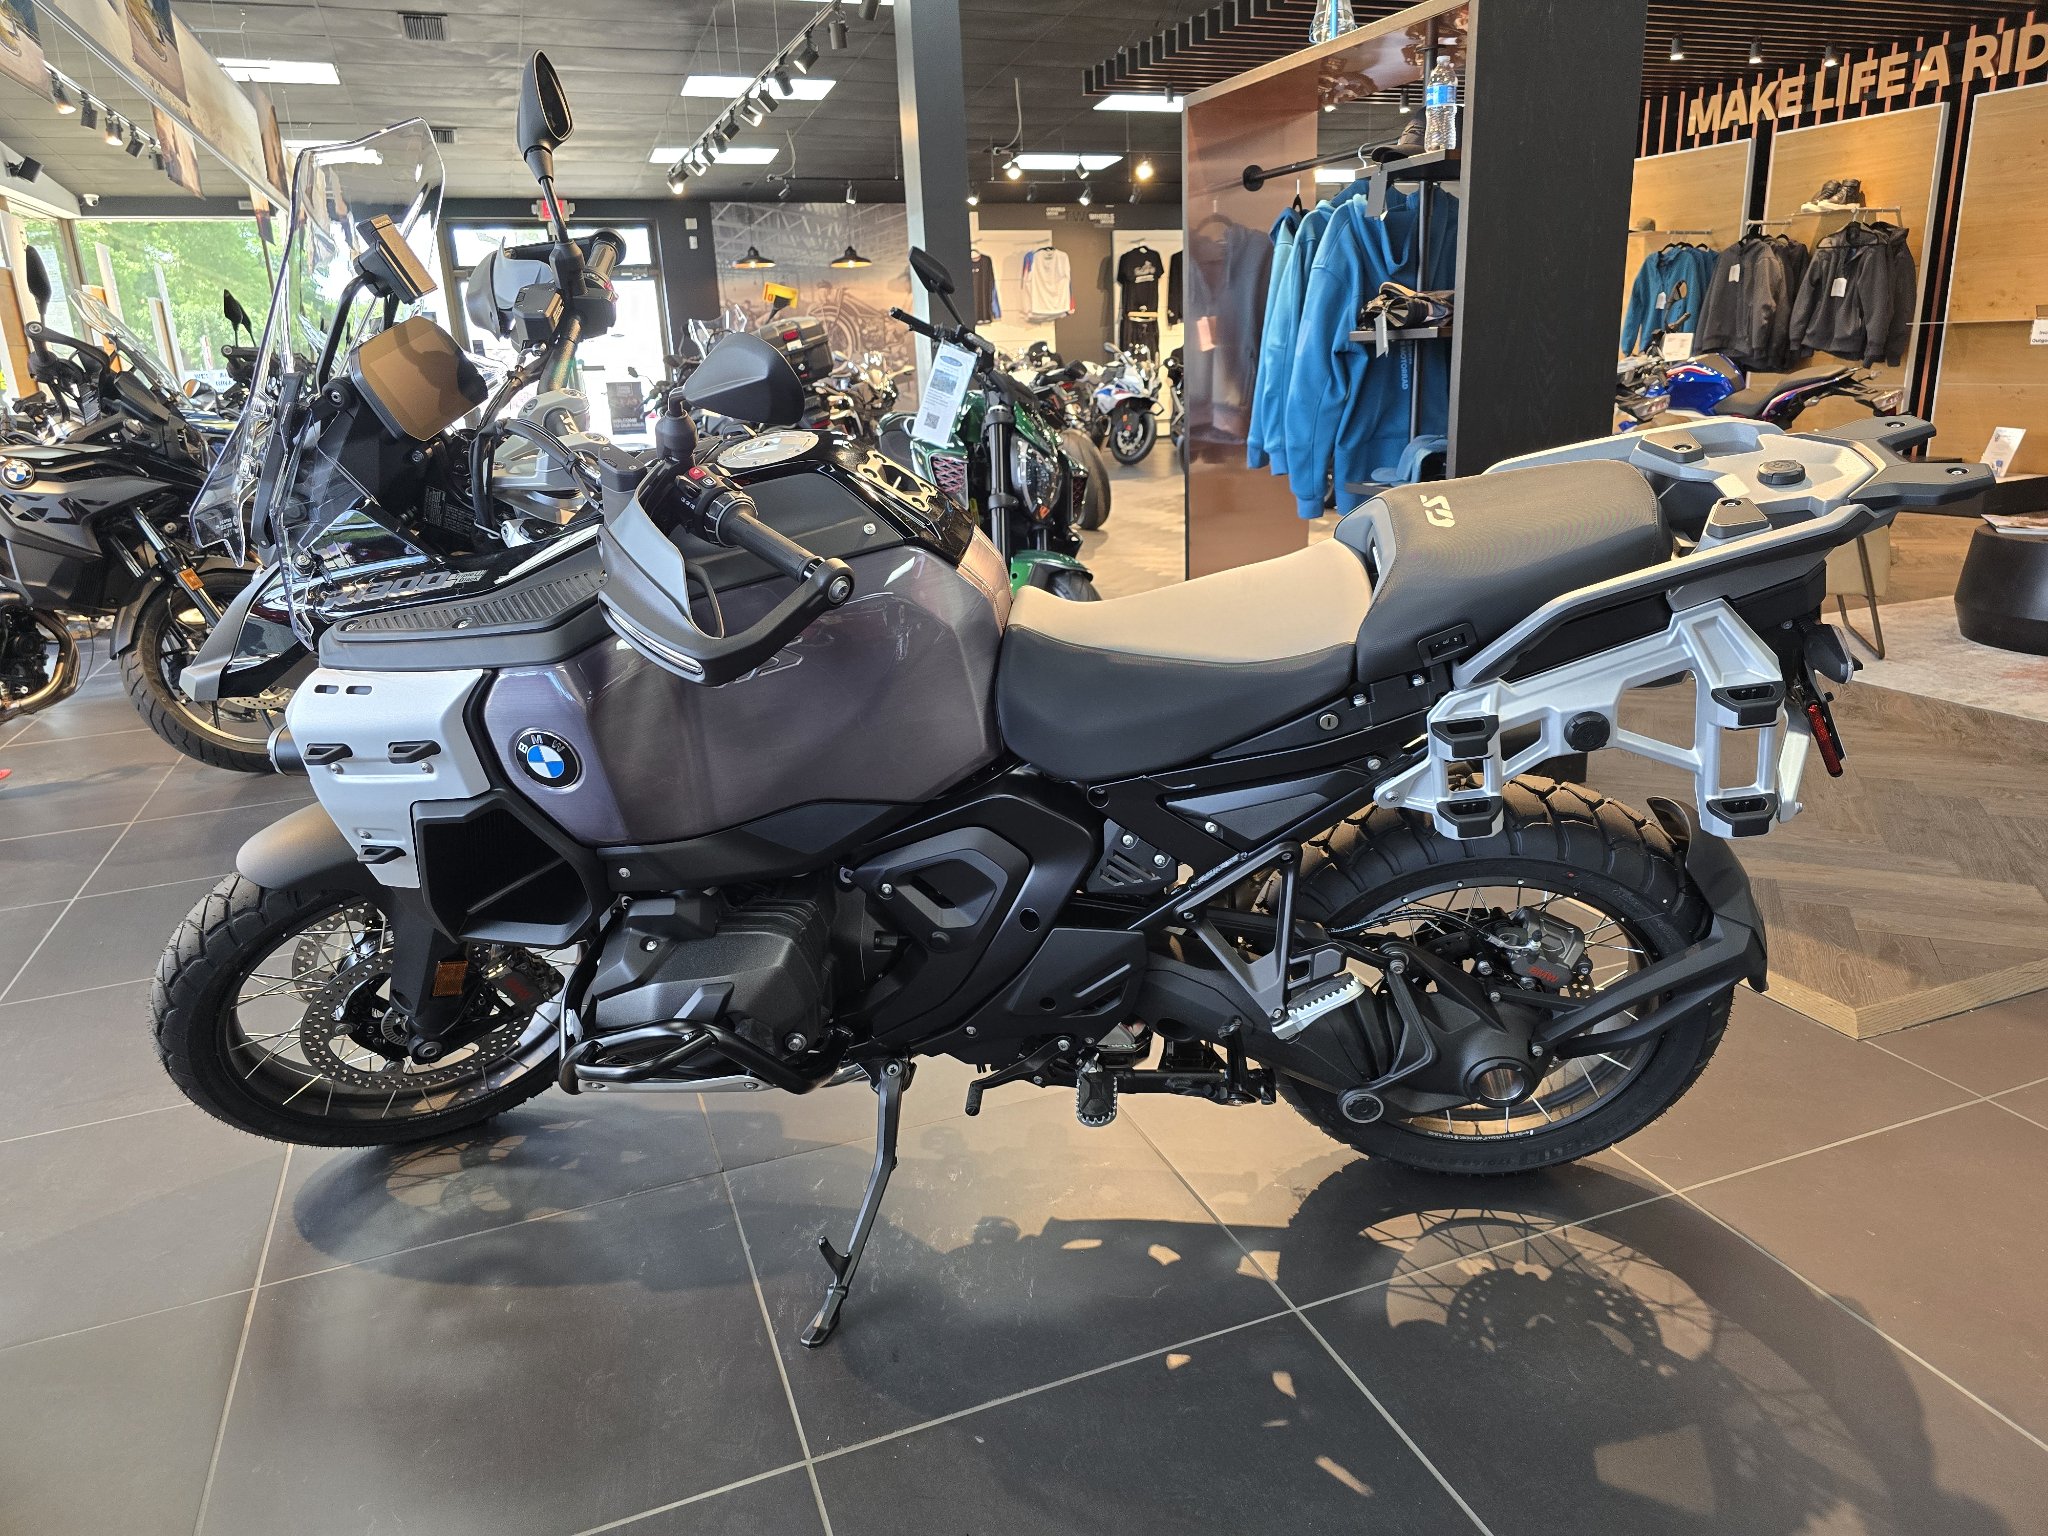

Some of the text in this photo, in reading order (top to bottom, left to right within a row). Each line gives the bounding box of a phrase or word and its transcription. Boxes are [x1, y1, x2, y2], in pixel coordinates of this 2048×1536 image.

[1687, 74, 1806, 136] MAKE
[1812, 52, 1909, 111] LIFE
[1912, 44, 1951, 92] A
[517, 734, 566, 755] BMW
